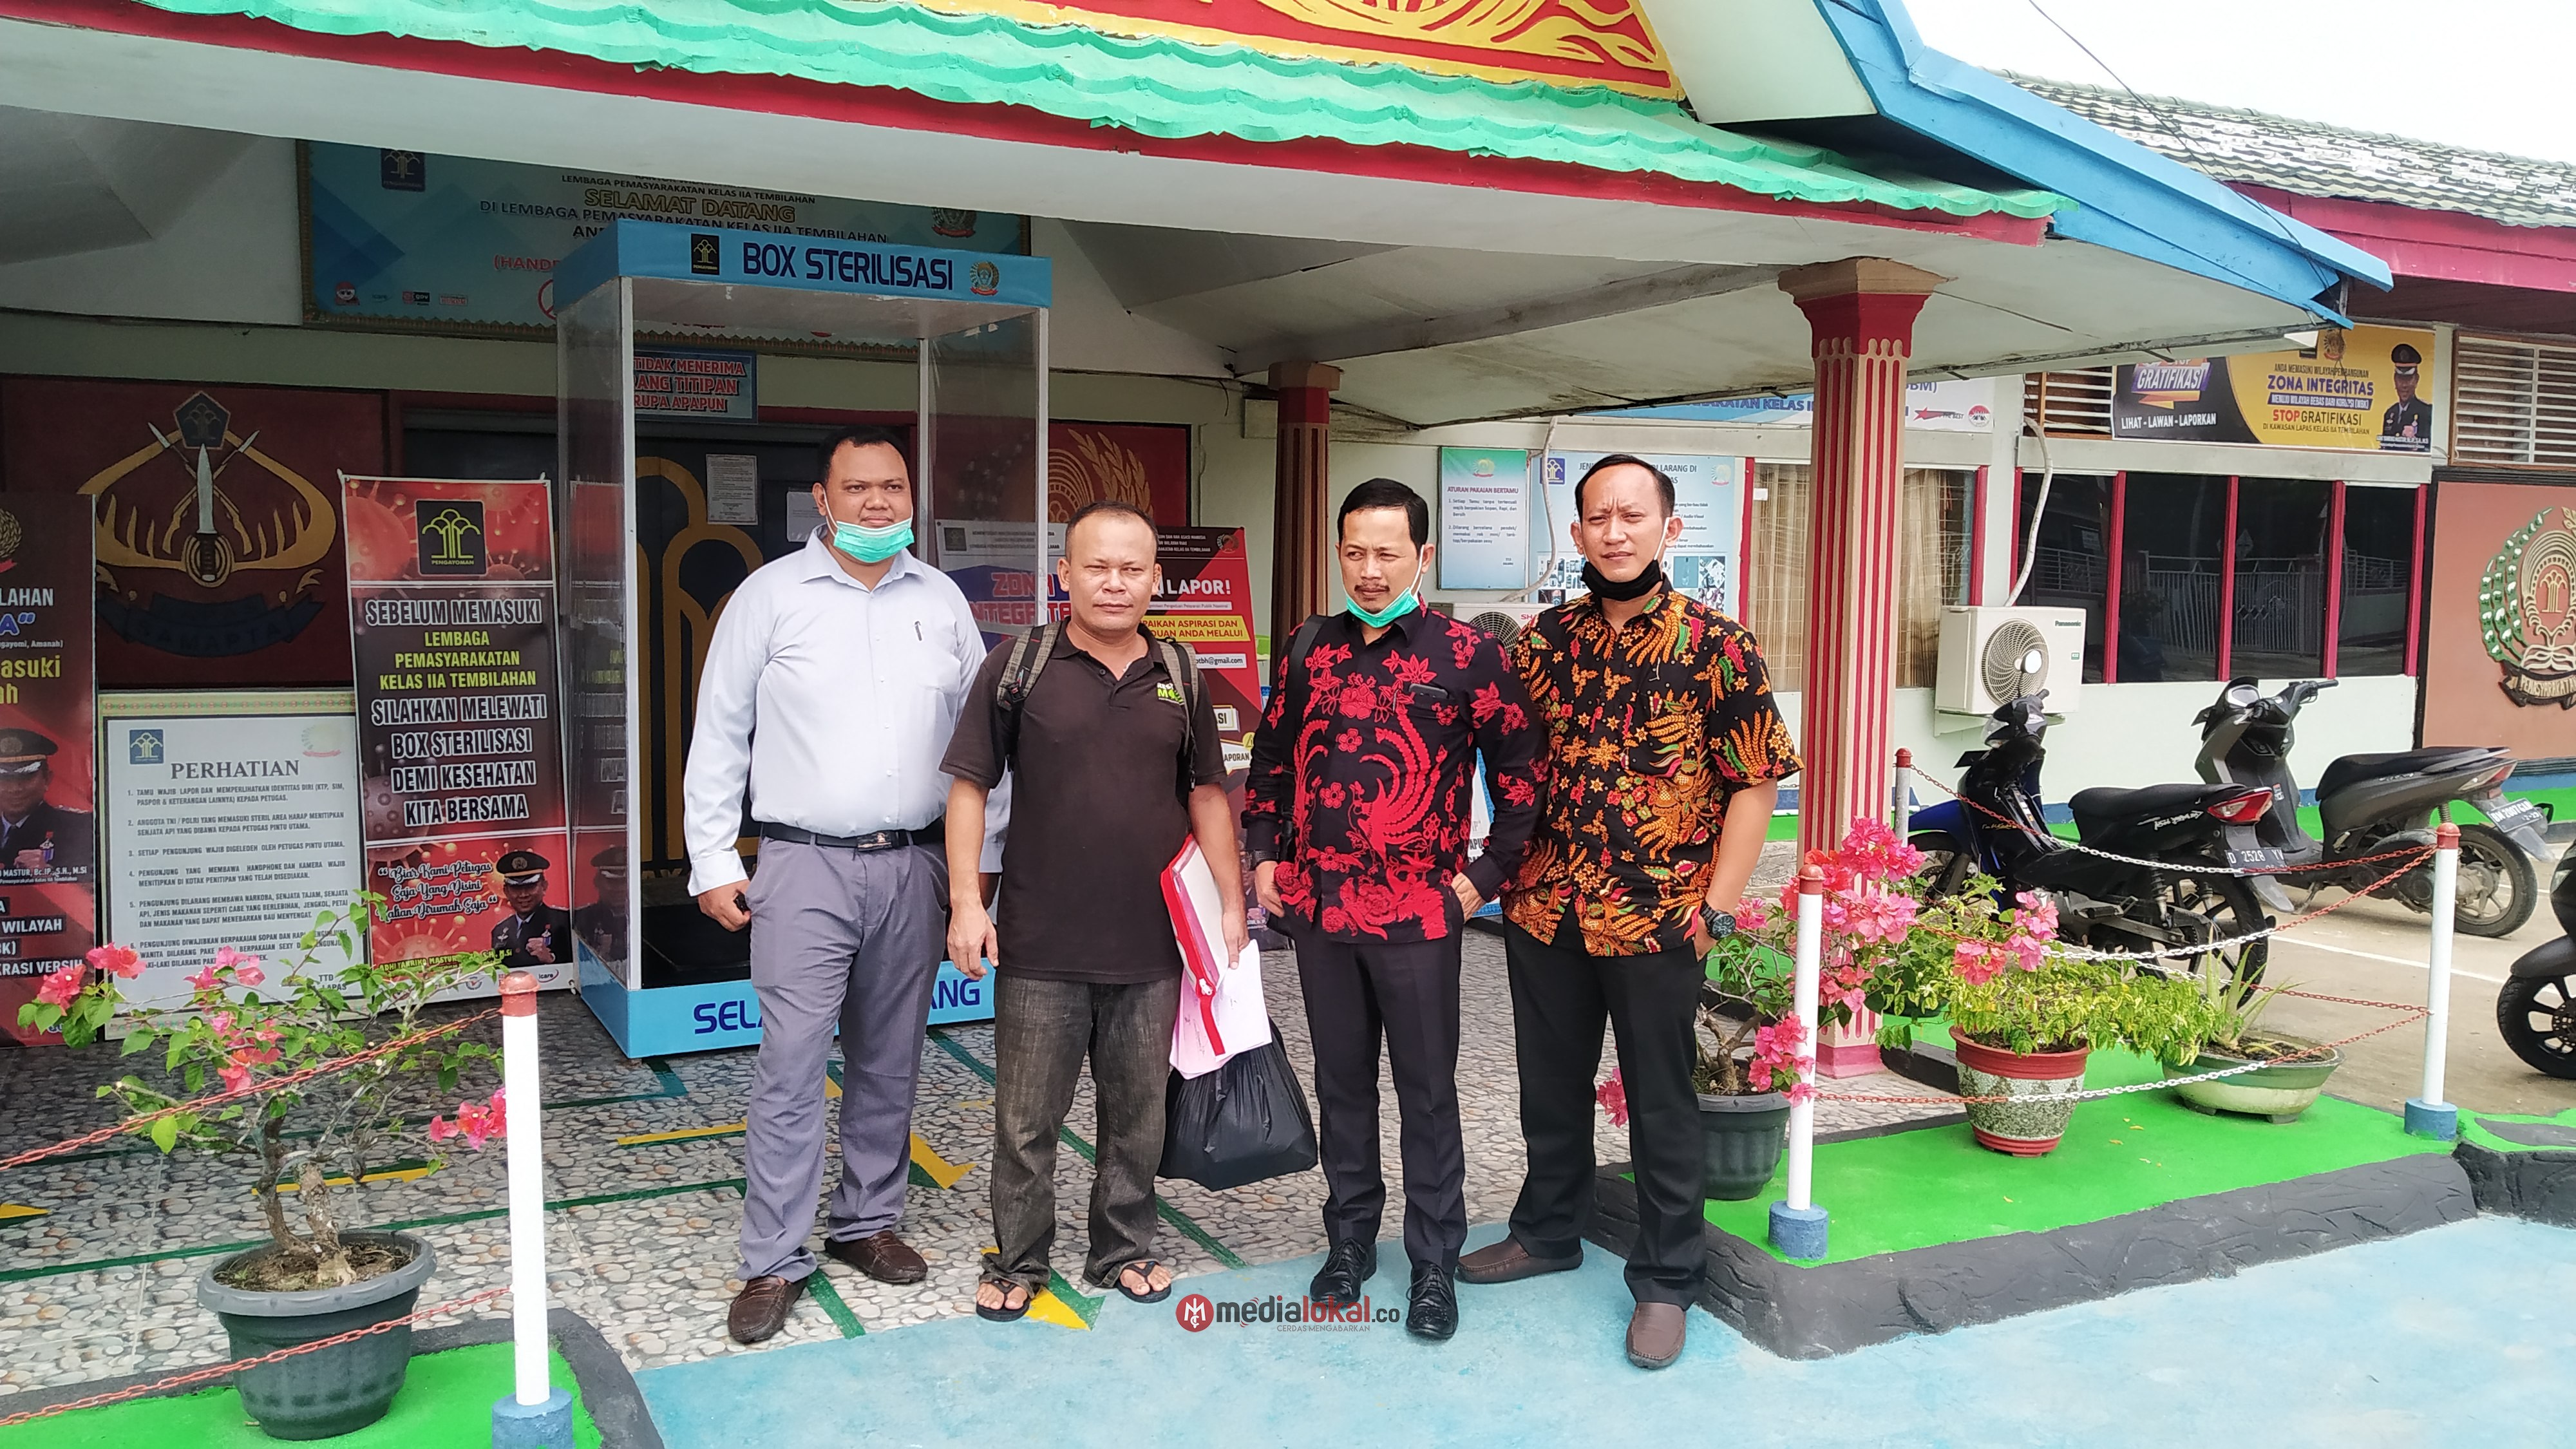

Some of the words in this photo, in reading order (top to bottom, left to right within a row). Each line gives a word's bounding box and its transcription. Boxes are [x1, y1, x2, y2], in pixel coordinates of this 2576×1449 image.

[562, 175, 612, 187] LEMBAGA
[614, 180, 705, 195] PEMASYARAKATAN
[708, 188, 737, 198] KELAS
[754, 192, 816, 204] TEMBILAHAN
[480, 200, 497, 213] DI
[501, 203, 578, 220] LEMBAGA
[584, 188, 697, 215] SELAMAT
[701, 198, 795, 223] DATANG
[743, 242, 798, 278] BOX
[805, 248, 954, 291] STERILISASI
[675, 357, 746, 377] MENERIMA
[634, 375, 672, 392] ANG
[675, 375, 739, 395] TITIPAN
[2136, 366, 2207, 390] GRATIFIKASI
[2267, 374, 2304, 391] ZONA
[2306, 377, 2374, 396] INTEGRITAS
[672, 397, 727, 412] APAPUN
[1763, 399, 1804, 412] KELAS
[2121, 417, 2143, 430] LIHAT
[2148, 415, 2174, 428] LAWAN
[2179, 413, 2217, 427] LAPORKAN
[2273, 409, 2300, 422] STOP
[2301, 410, 2362, 426] GRATIFIKASI
[2269, 423, 2295, 431] KAWASAN
[2296, 424, 2312, 432] LAPAS
[1660, 464, 1688, 473] LARANG
[1166, 579, 1231, 595] LAPOR!
[365, 599, 448, 627] SEBELUM
[450, 598, 543, 625] MEMASUKI
[1178, 620, 1217, 628] ASPIRASI
[1218, 620, 1238, 628] DAN
[424, 630, 490, 648] LEMBAGA
[1179, 629, 1205, 638] ANDA
[1207, 629, 1243, 638] MELALUI
[395, 650, 520, 668] PEMASYARAKATAN
[379, 674, 423, 690] KELAS
[427, 673, 446, 689] IIA
[449, 670, 536, 688] TEMBILAHAN
[371, 697, 458, 726] SILAHKAN
[460, 694, 547, 723] MELEWATI
[391, 732, 429, 759] BOX
[430, 727, 533, 757] STERILISASI
[170, 759, 299, 780] PERHATIAN
[390, 766, 438, 794] DEMI
[440, 760, 537, 790] KESEHATAN
[216, 785, 270, 793] MEMPERLIHATKAN
[271, 784, 301, 792] IDENTITAS
[169, 797, 207, 806] KETERANGAN
[403, 799, 444, 827] KITA
[445, 793, 529, 824] BERSAMA
[218, 815, 250, 823] MEMASUKI
[309, 811, 345, 820] MENITIPKAN
[162, 847, 203, 856] PENGUNJUNG
[278, 842, 304, 851] PETUGAS
[323, 840, 345, 849] UTAMA.
[2228, 852, 2237, 864] D
[2241, 850, 2266, 862] 2528
[1, 918, 62, 933] WILAYAH
[140, 940, 180, 949] PENGUNJUNG
[182, 938, 219, 946] DIWAJIBKAN
[220, 934, 257, 943] BERPAKAIAN
[258, 933, 278, 942] SOPAN
[0, 961, 33, 976] RASI
[318, 974, 334, 982] TTD
[694, 999, 763, 1035] SEL
[930, 978, 981, 1010] NG
